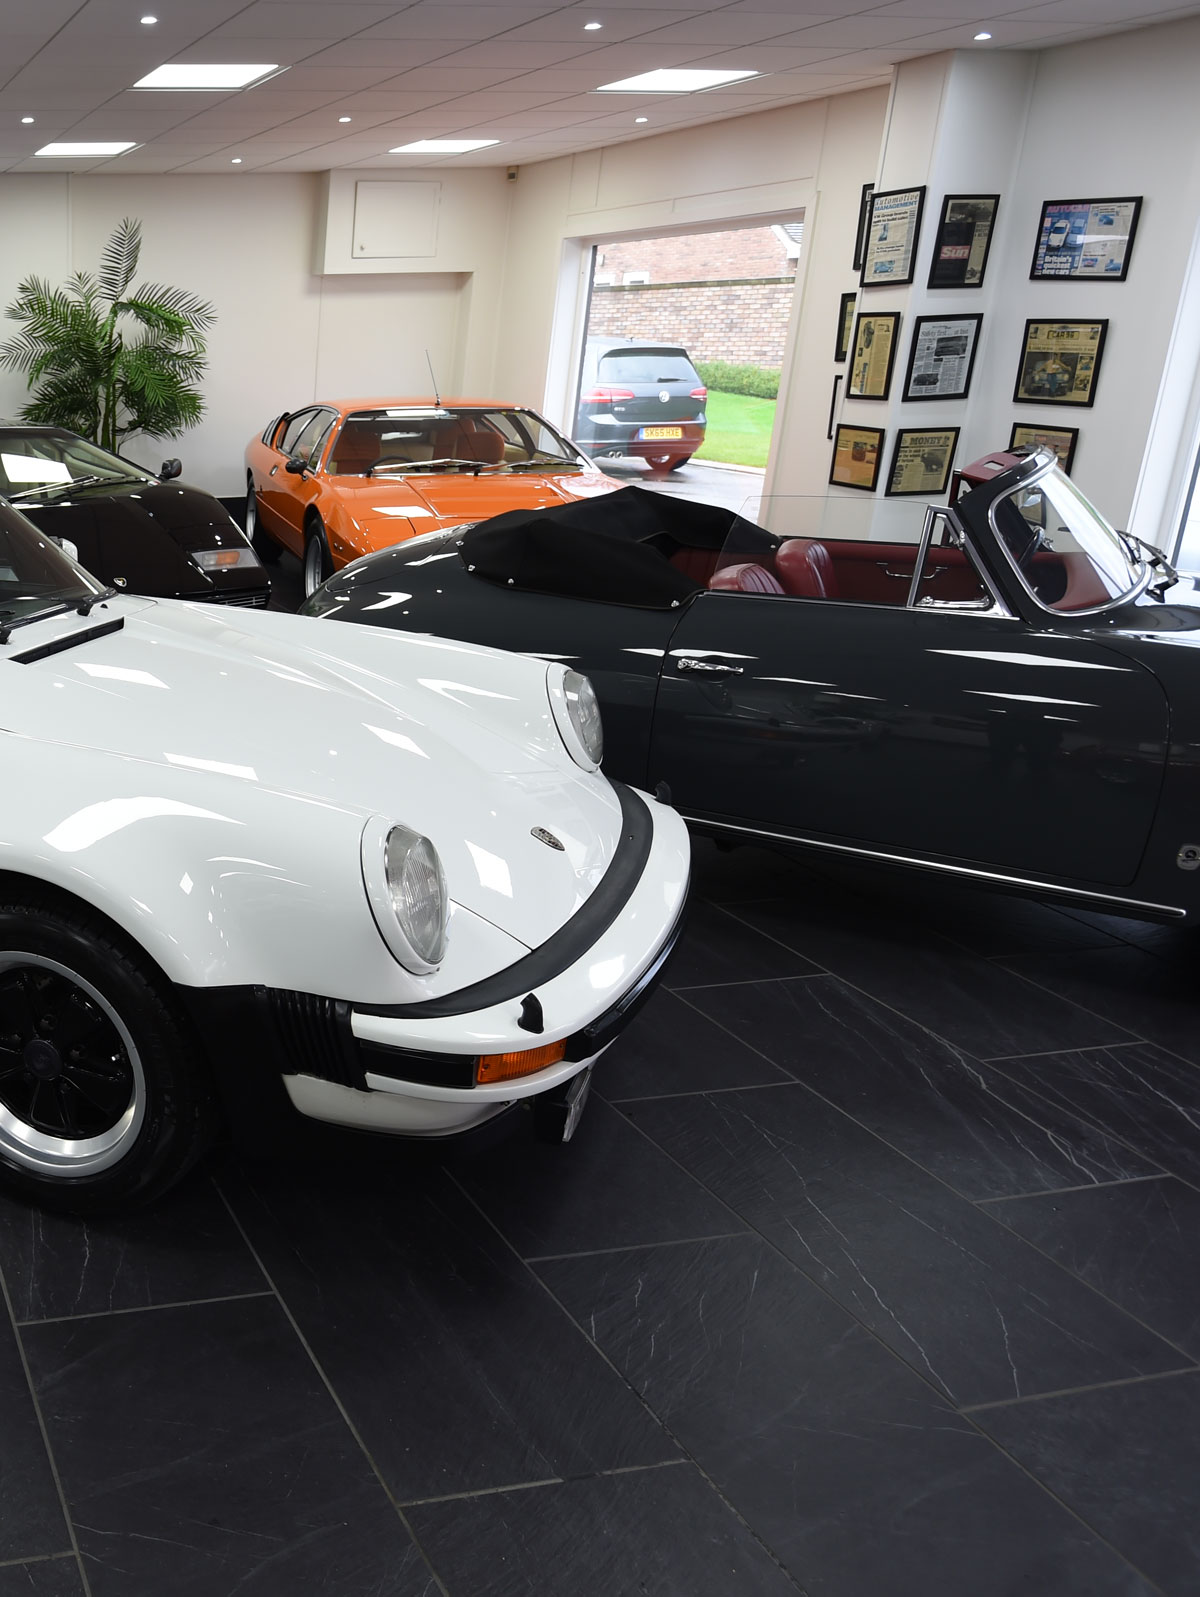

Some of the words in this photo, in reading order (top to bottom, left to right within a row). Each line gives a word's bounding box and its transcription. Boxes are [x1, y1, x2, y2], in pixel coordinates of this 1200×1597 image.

[875, 193, 919, 206] Automotive
[874, 200, 918, 211] MANAGEMENT
[1047, 204, 1090, 213] AUTOCAR
[942, 247, 969, 257] Sun
[910, 436, 943, 445] MONEY
